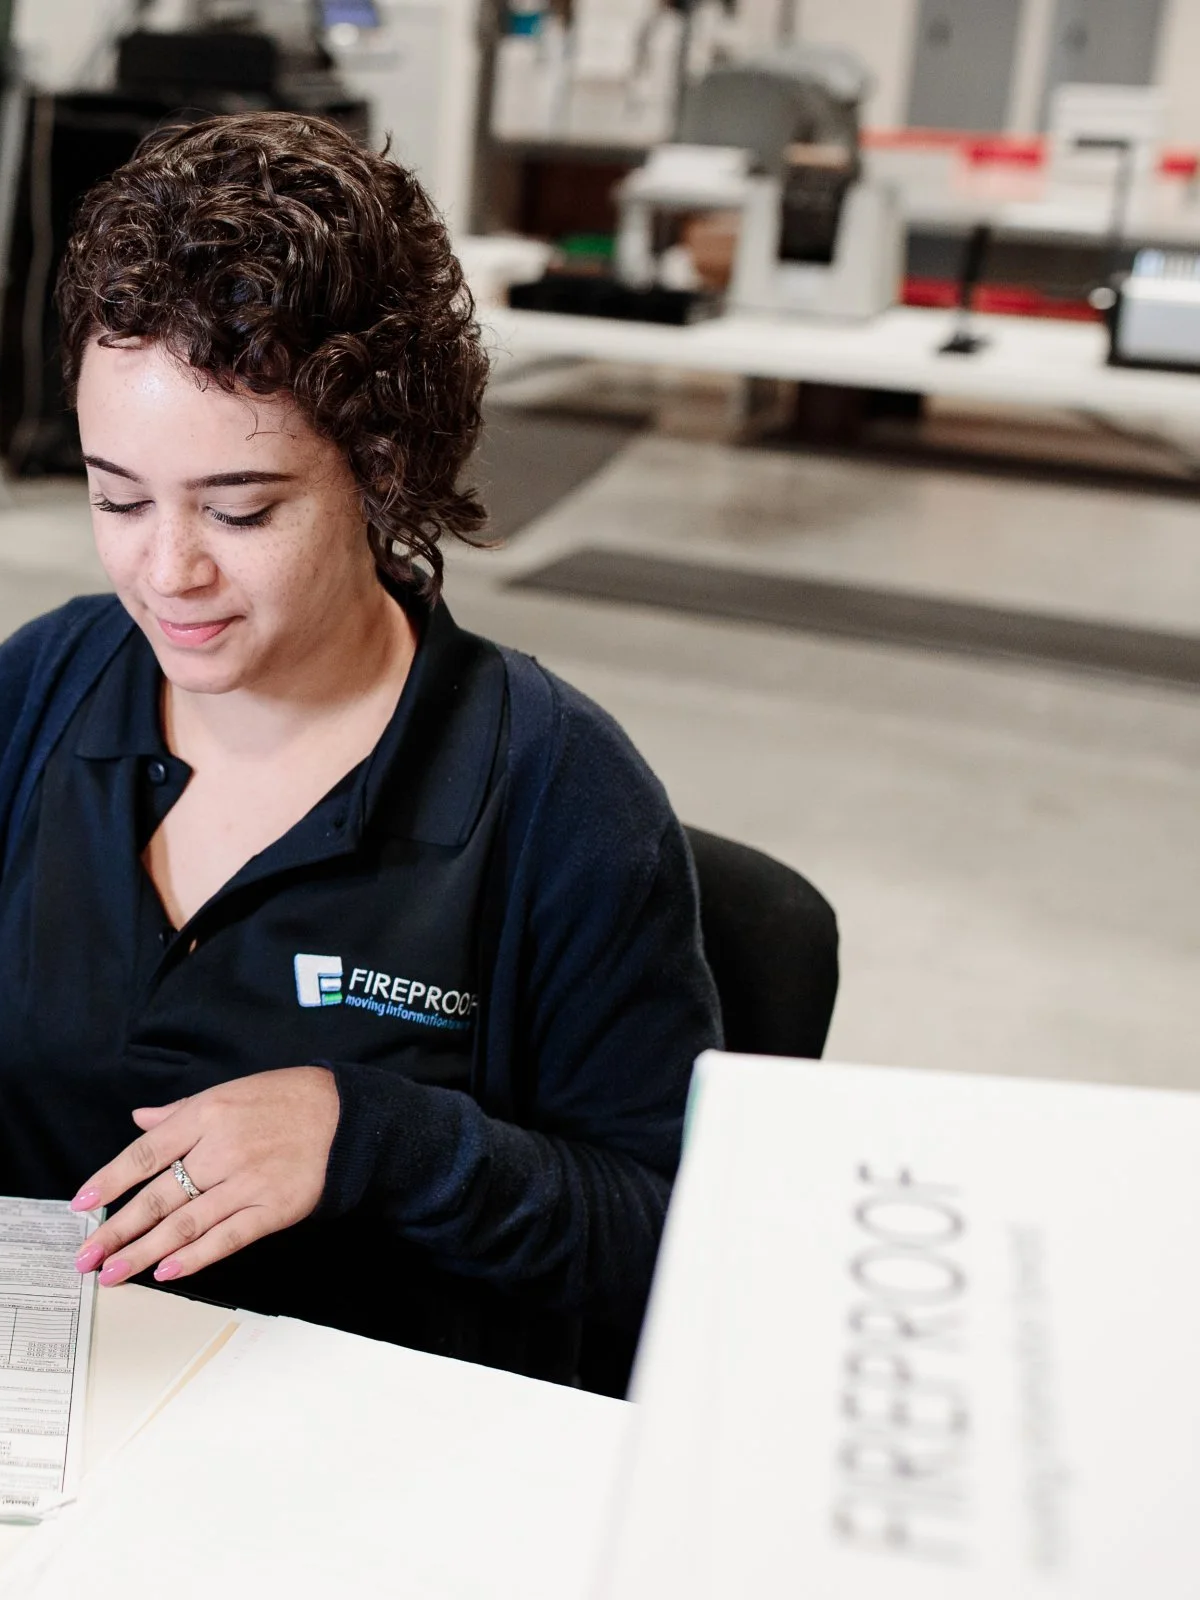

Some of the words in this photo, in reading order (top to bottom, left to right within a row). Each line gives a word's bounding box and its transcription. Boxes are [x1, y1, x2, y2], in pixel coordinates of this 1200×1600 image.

[345, 994, 386, 1016] moving
[386, 1001, 449, 1027] information
[349, 967, 479, 1016] FIREPROOF
